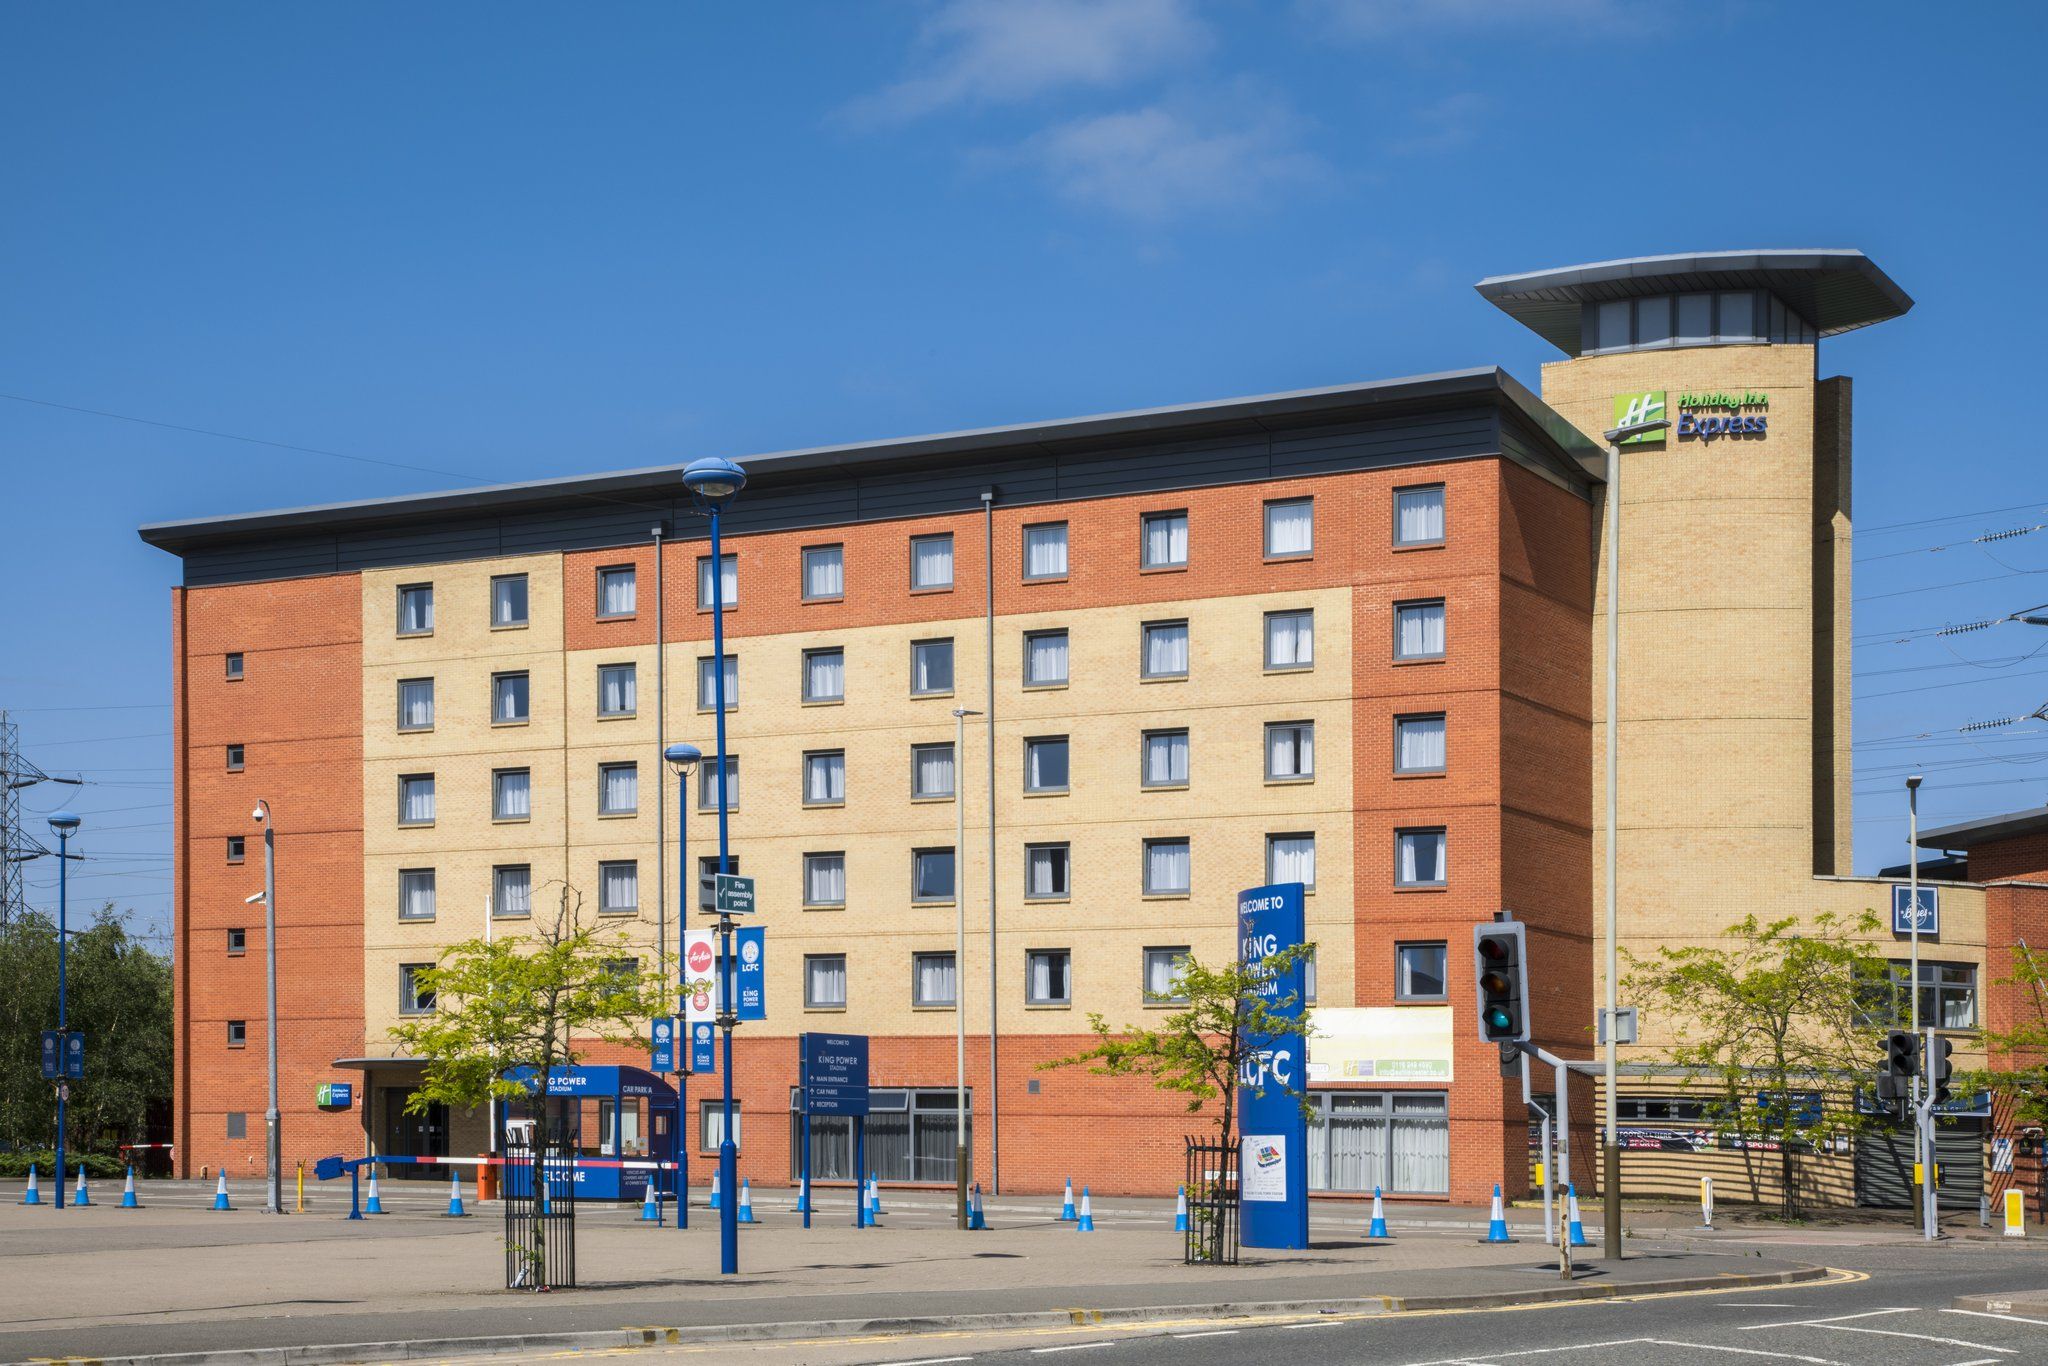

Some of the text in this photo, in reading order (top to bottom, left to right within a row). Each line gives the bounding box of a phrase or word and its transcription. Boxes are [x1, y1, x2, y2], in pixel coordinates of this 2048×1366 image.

[1677, 389, 1769, 409] Holiday Inn
[1677, 413, 1768, 440] Express
[734, 881, 746, 889] Fire
[727, 890, 753, 900] assembly
[733, 900, 748, 908] point
[1240, 896, 1284, 915] WELCOME TO
[1242, 934, 1278, 959] KING
[741, 963, 760, 972] LCFC
[818, 1056, 858, 1065] KING POWER
[1240, 1050, 1291, 1086] LCFC
[557, 1077, 587, 1086] POWER
[622, 1085, 634, 1093] CAR
[634, 1086, 648, 1094] PARK
